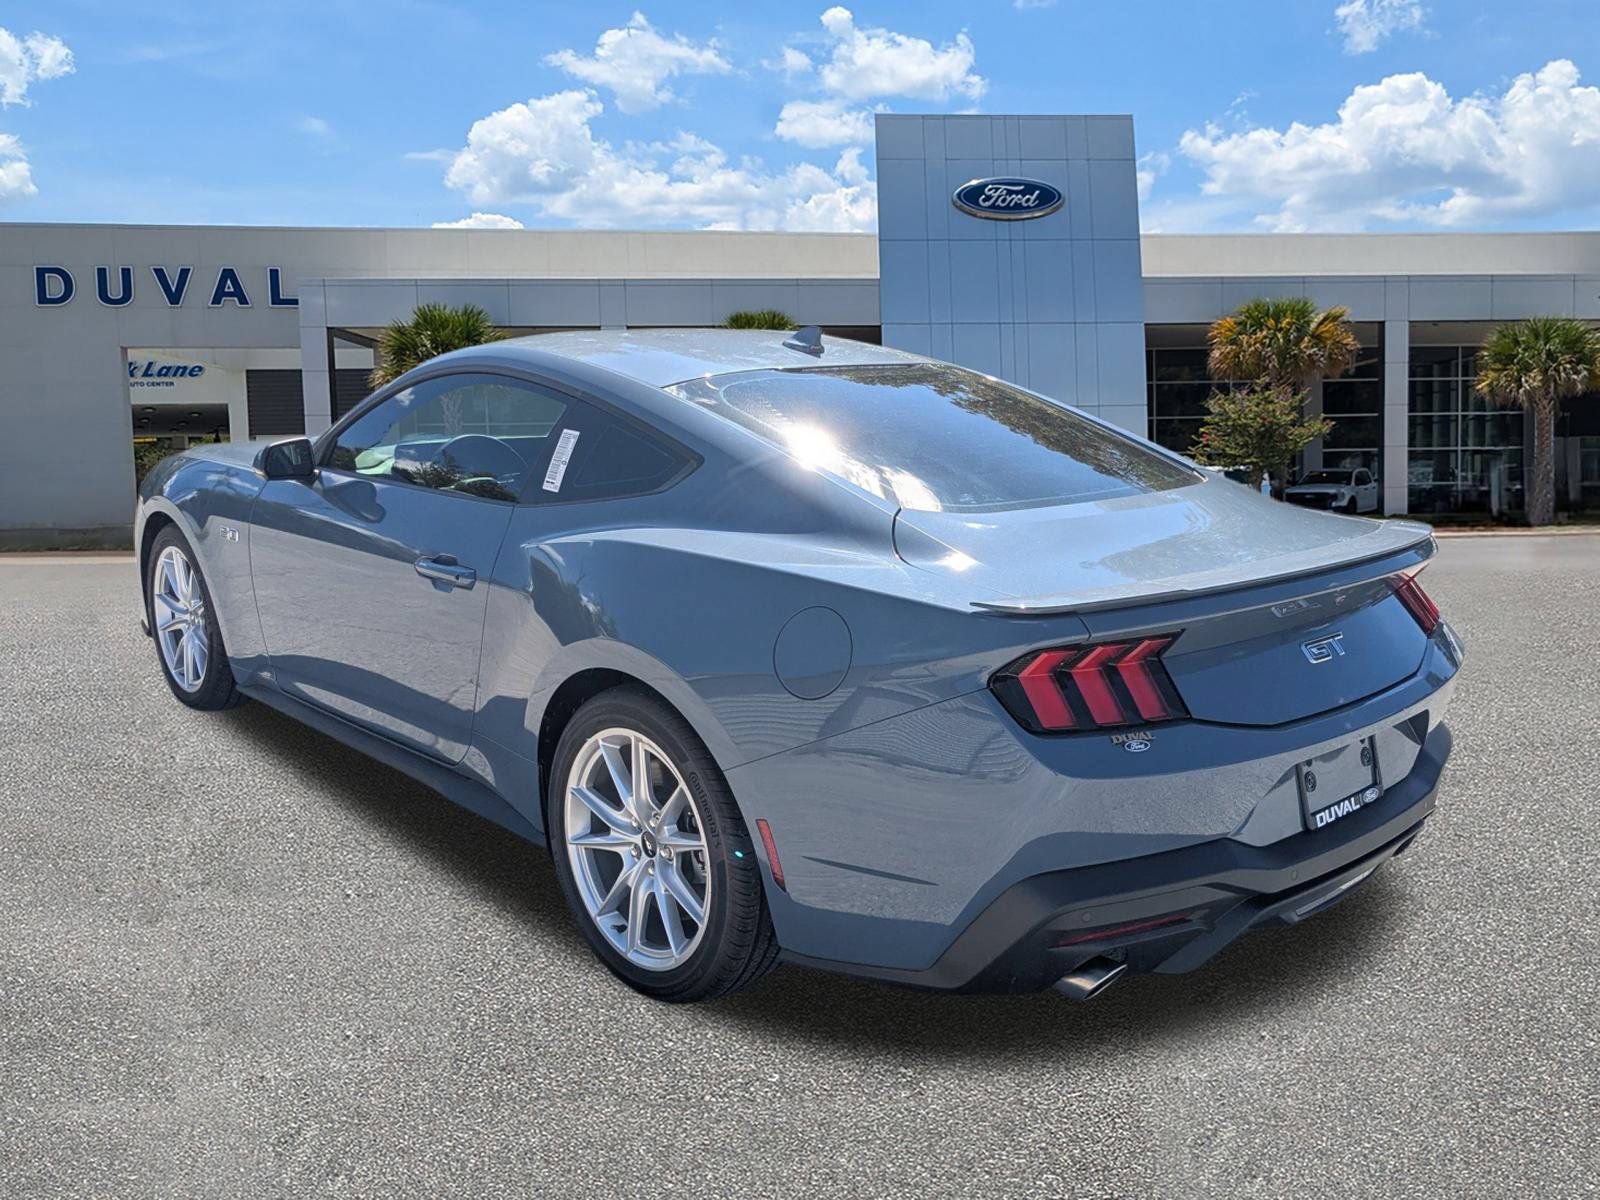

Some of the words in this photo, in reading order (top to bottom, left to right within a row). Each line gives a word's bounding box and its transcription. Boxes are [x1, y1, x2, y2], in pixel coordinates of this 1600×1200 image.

[979, 184, 1040, 207] Ford
[34, 265, 299, 307] DUVAL
[141, 361, 204, 378] Lane
[1301, 632, 1345, 664] GT
[1111, 731, 1156, 744] DUVAL
[1315, 797, 1360, 828] DUVAL
